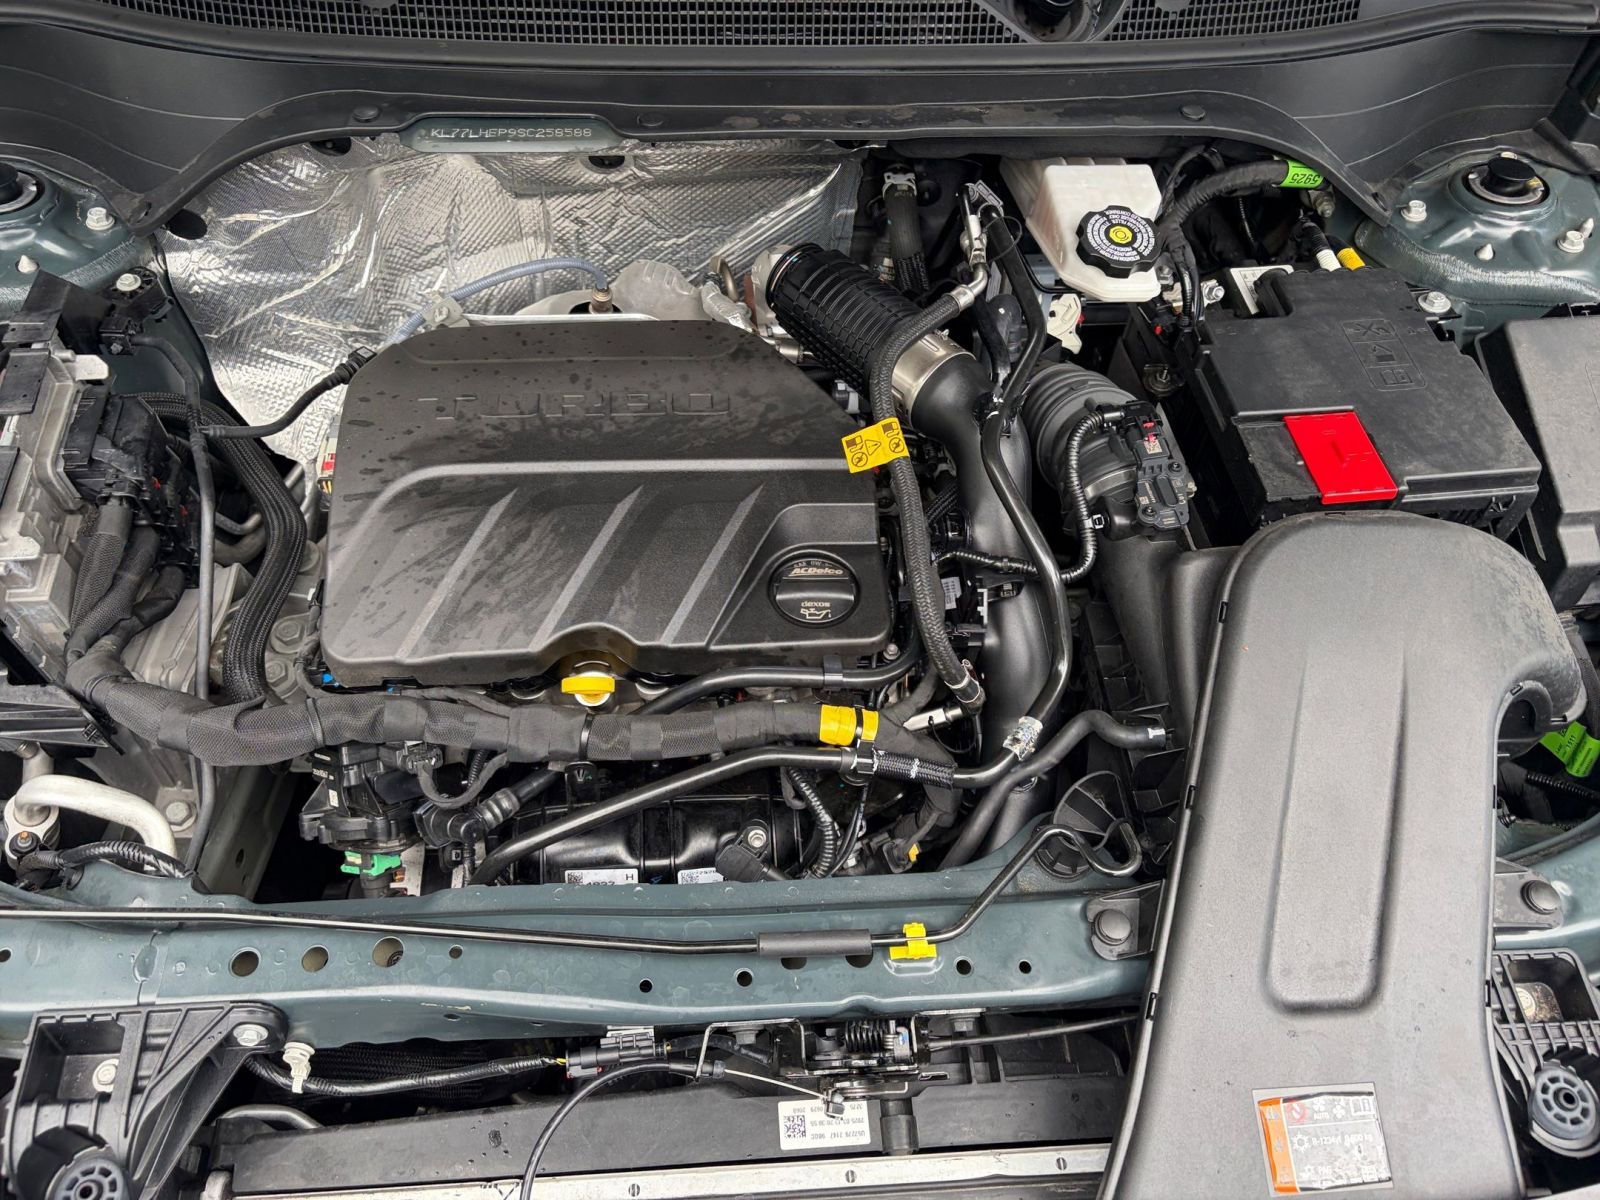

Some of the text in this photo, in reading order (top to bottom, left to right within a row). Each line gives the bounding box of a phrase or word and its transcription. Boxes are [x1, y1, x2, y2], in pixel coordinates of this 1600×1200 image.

[1289, 172, 1321, 185] 5925
[418, 392, 731, 420] TURBO
[788, 567, 843, 576] ACDelco
[801, 600, 831, 608] dexos
